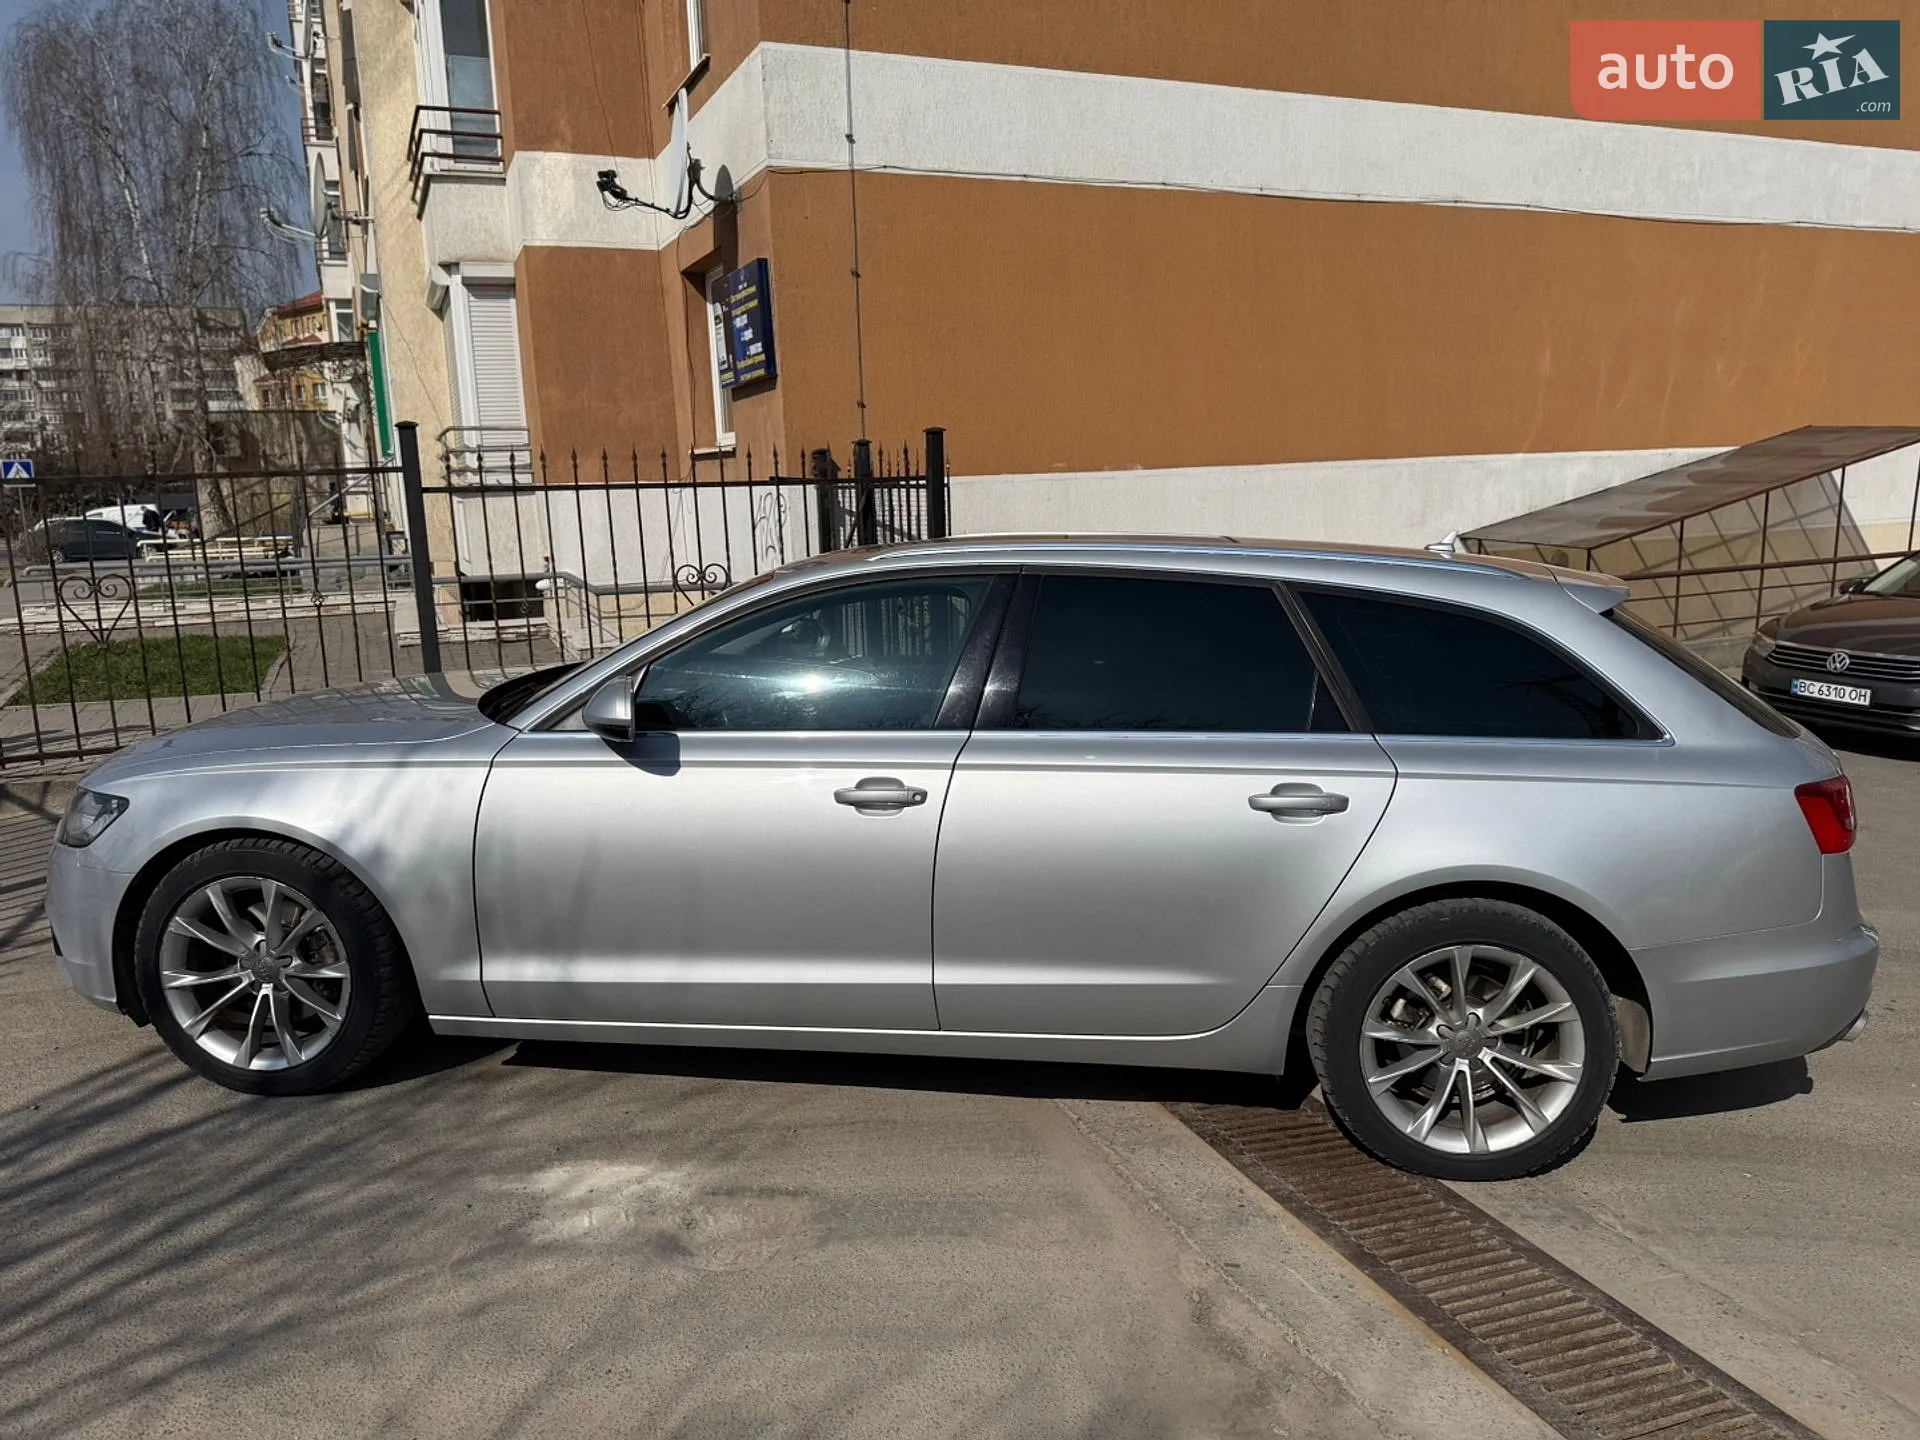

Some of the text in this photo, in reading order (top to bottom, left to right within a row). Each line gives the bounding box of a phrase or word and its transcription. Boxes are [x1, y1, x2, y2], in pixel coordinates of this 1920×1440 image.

[1799, 682, 1867, 702] BC 6310 OH
